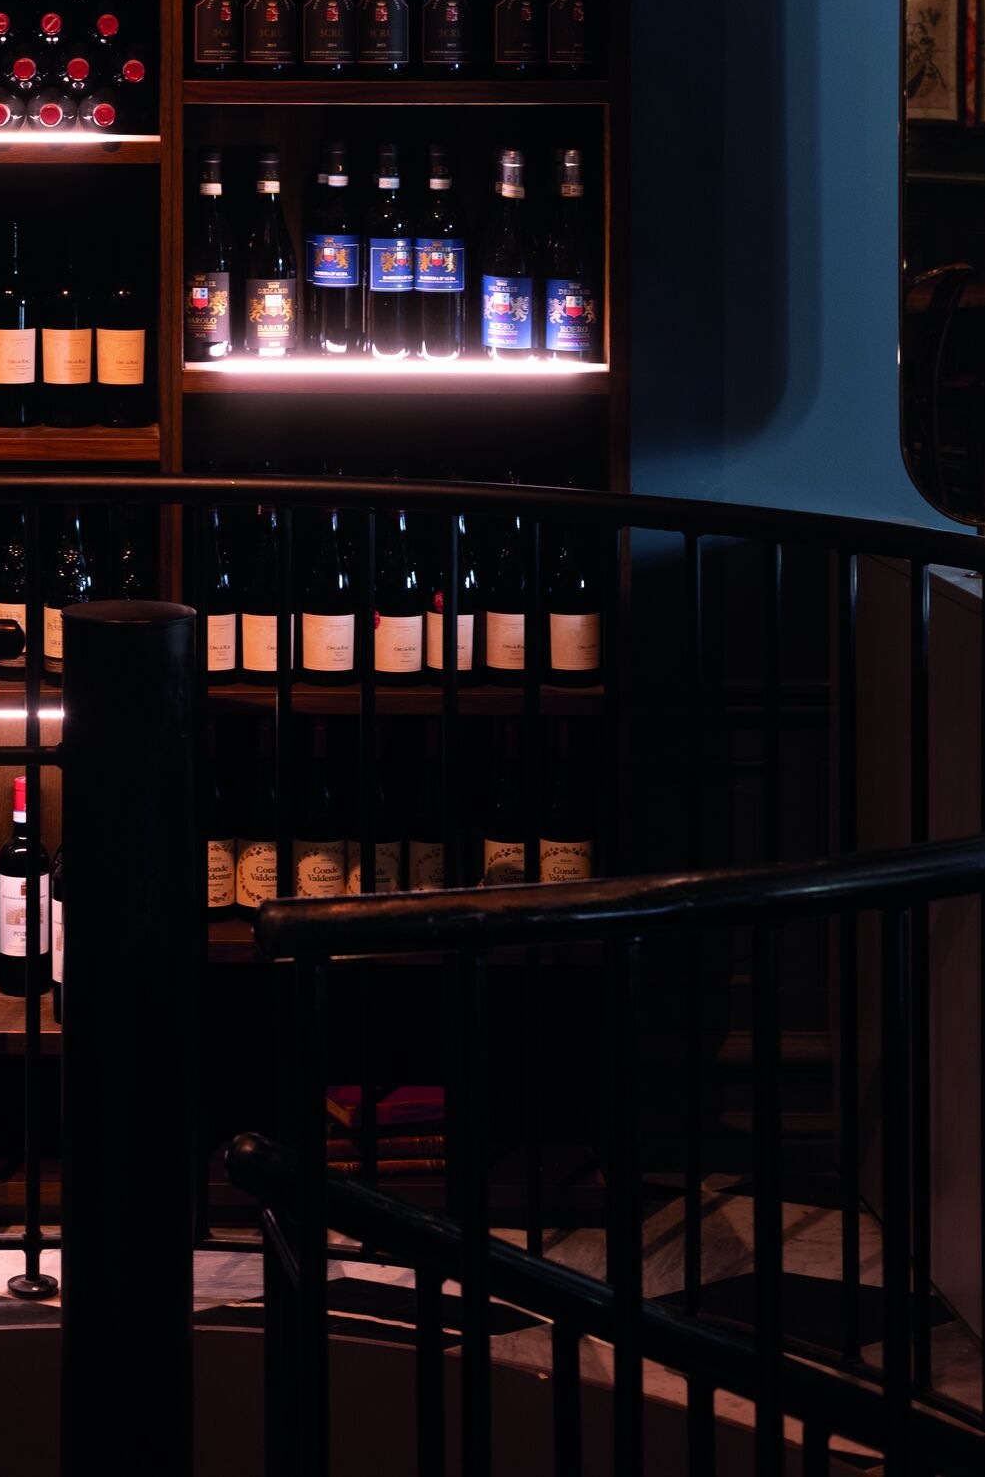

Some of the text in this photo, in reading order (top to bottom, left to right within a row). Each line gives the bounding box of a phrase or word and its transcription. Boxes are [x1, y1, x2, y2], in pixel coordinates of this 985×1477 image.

[257, 324, 290, 332] BAROLO
[560, 325, 589, 334] ROERO
[255, 865, 277, 874] Cond
[312, 866, 337, 875] Conde
[552, 867, 579, 875] Conde
[307, 874, 343, 883] Valdemar
